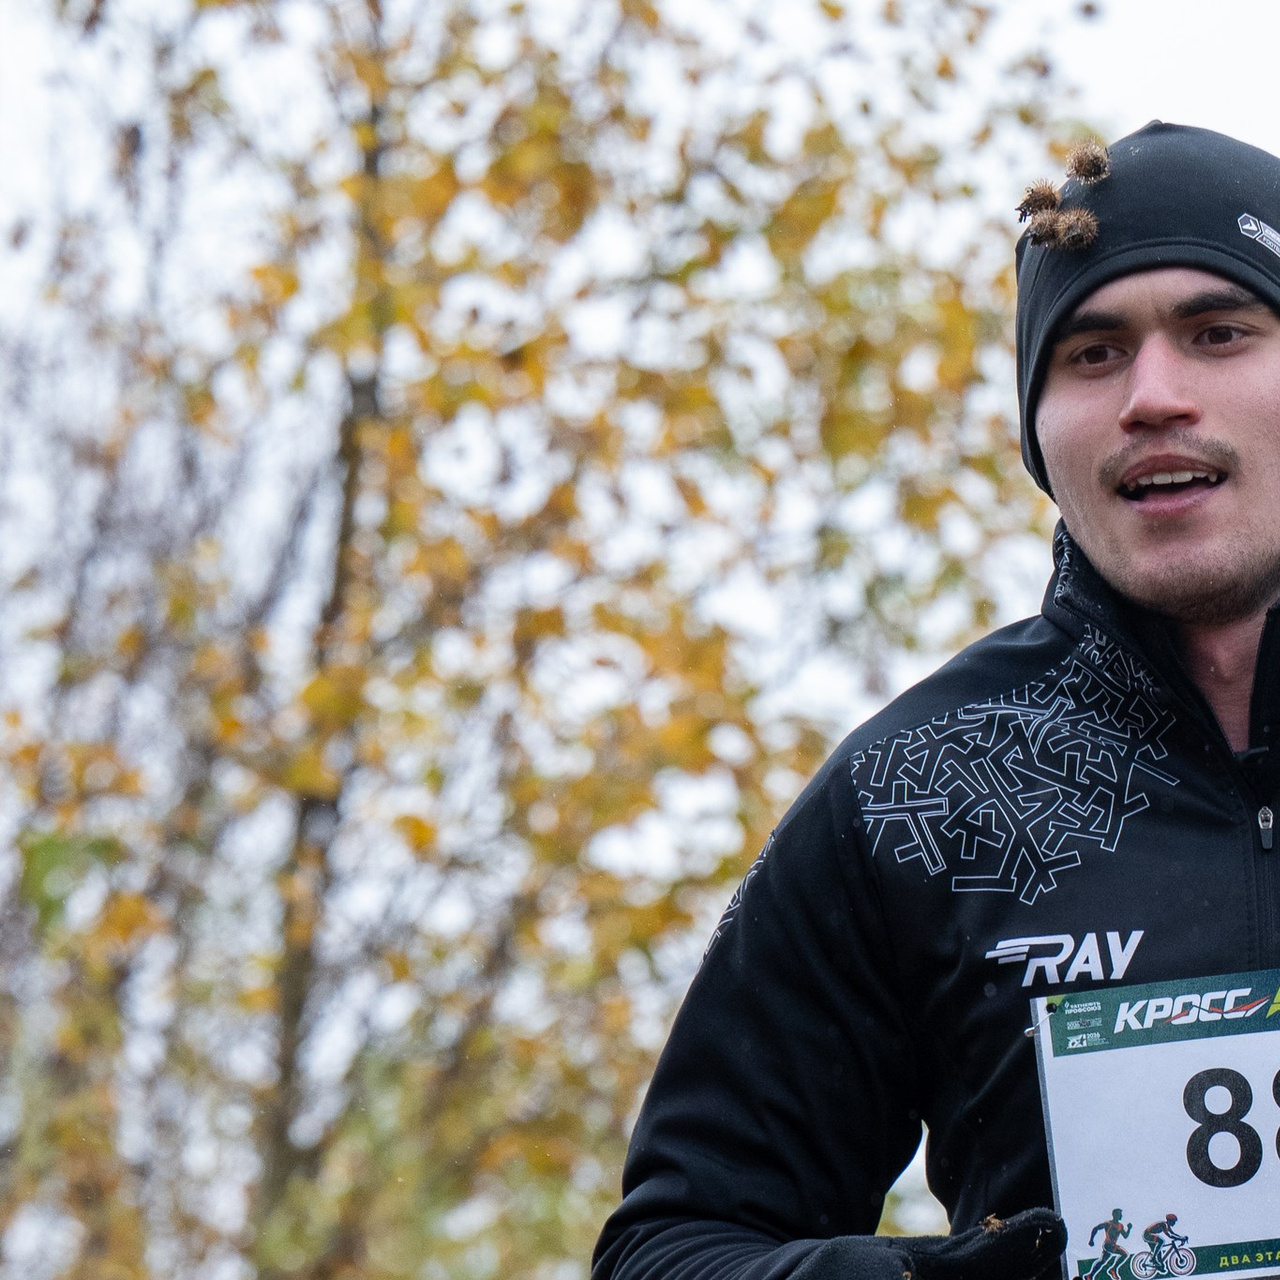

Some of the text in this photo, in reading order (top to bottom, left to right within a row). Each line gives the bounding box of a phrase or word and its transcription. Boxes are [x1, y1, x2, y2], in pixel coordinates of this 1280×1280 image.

[985, 930, 1144, 987] RAY
[1114, 988, 1257, 1034] КРОСС
[1219, 1254, 1251, 1267] ДВА
